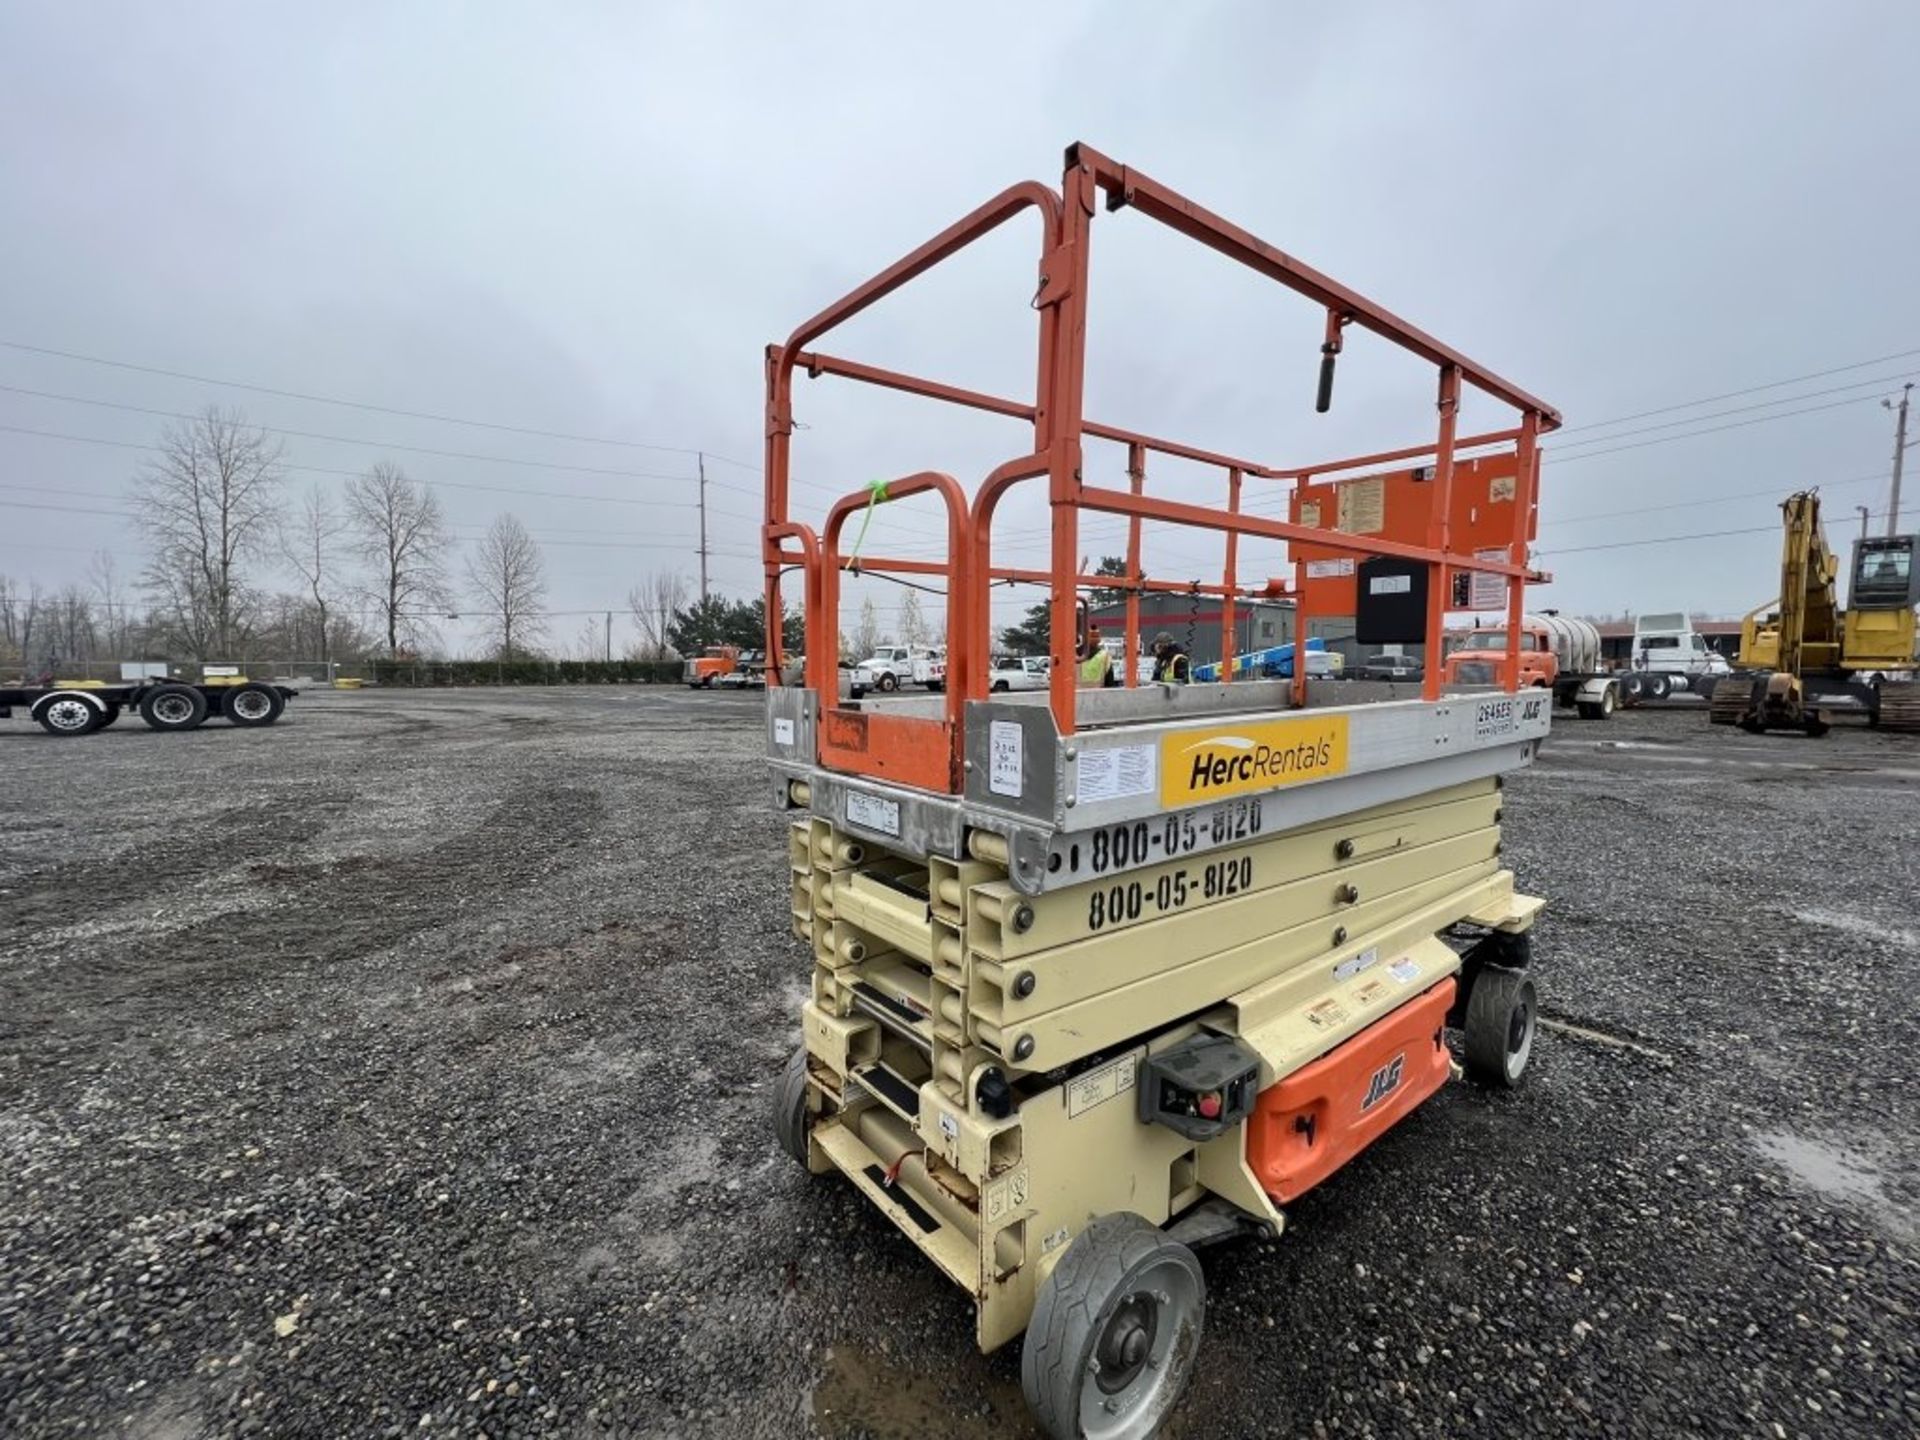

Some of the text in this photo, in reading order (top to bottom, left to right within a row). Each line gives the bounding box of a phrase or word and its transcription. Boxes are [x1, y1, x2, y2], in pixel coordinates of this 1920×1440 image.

[1522, 701, 1541, 720] JLG
[1092, 799, 1262, 872] 800-05-8120
[1089, 856, 1252, 930] 800-05-8120
[1362, 1053, 1404, 1111] JLG
